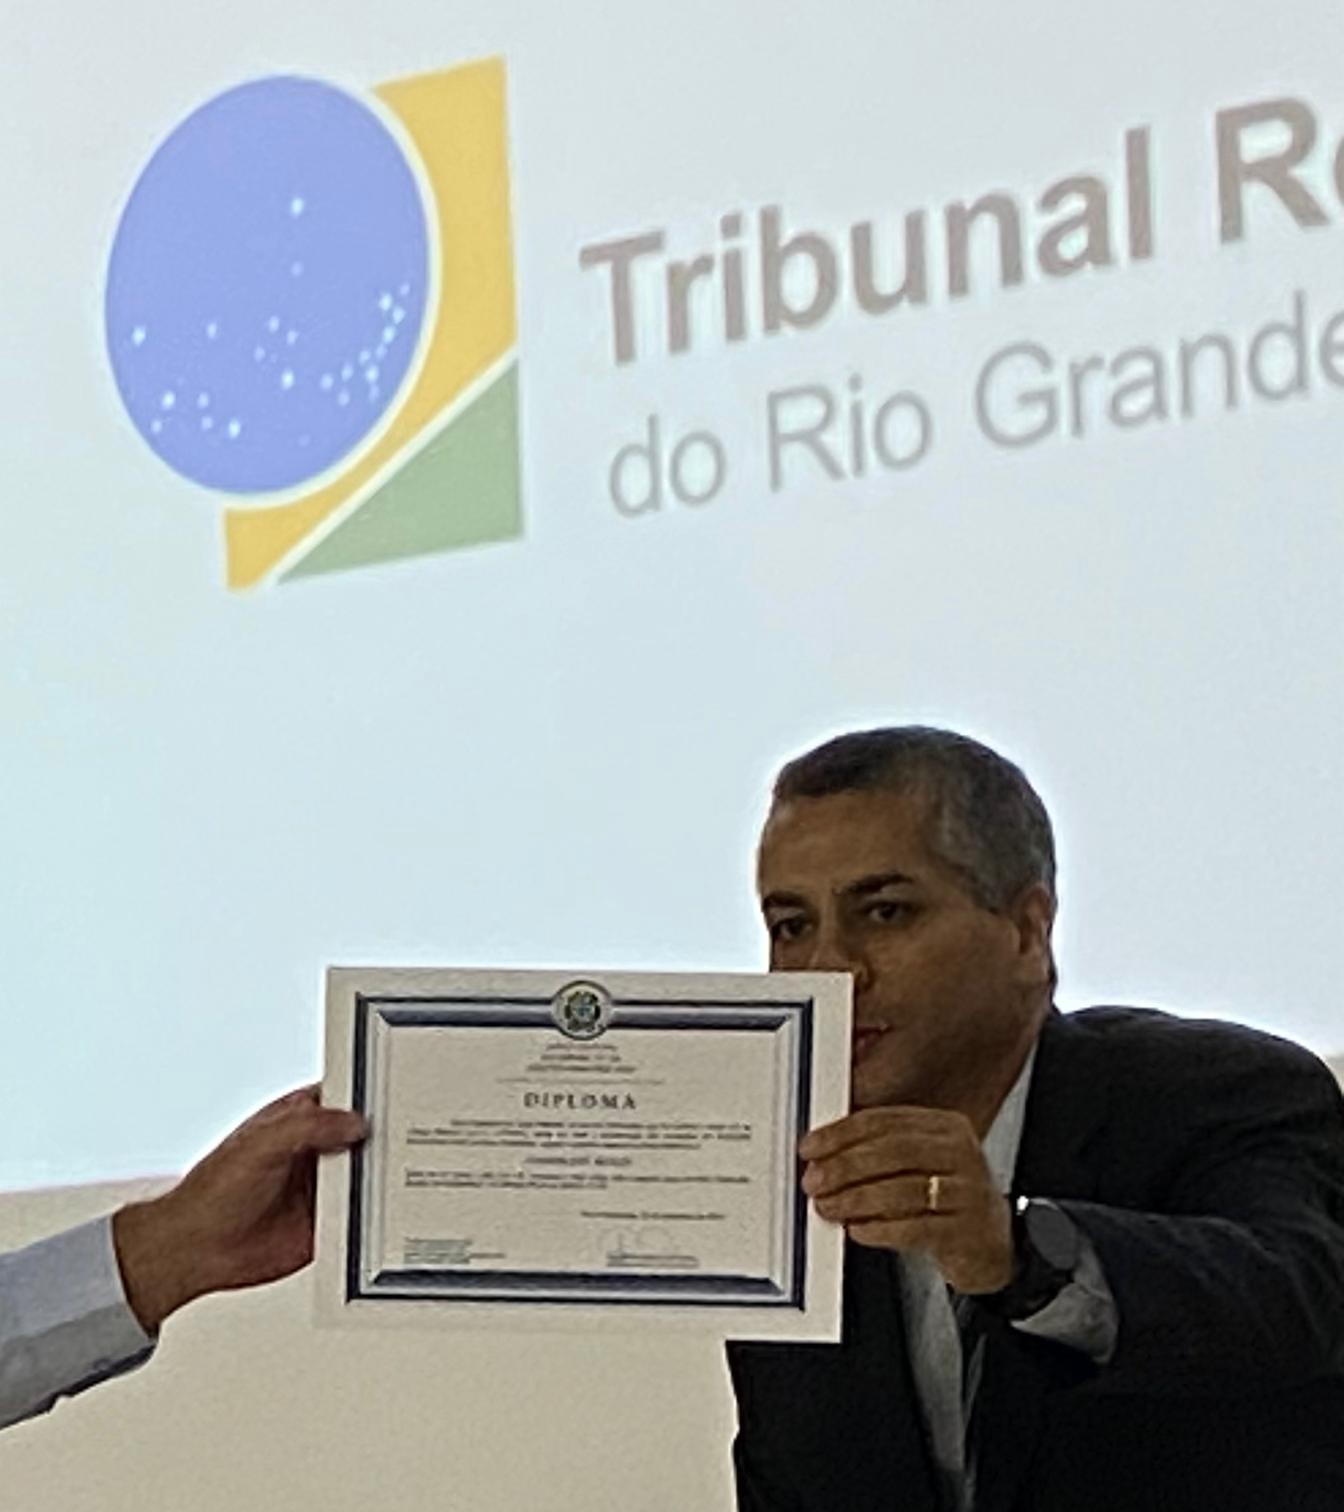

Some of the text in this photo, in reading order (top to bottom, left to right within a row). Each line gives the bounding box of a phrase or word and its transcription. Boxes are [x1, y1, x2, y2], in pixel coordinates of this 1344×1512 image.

[578, 95, 1344, 367] Tribunal R
[606, 412, 728, 520] do
[766, 372, 934, 492] Rio
[523, 1092, 637, 1110] DIPLOMA
